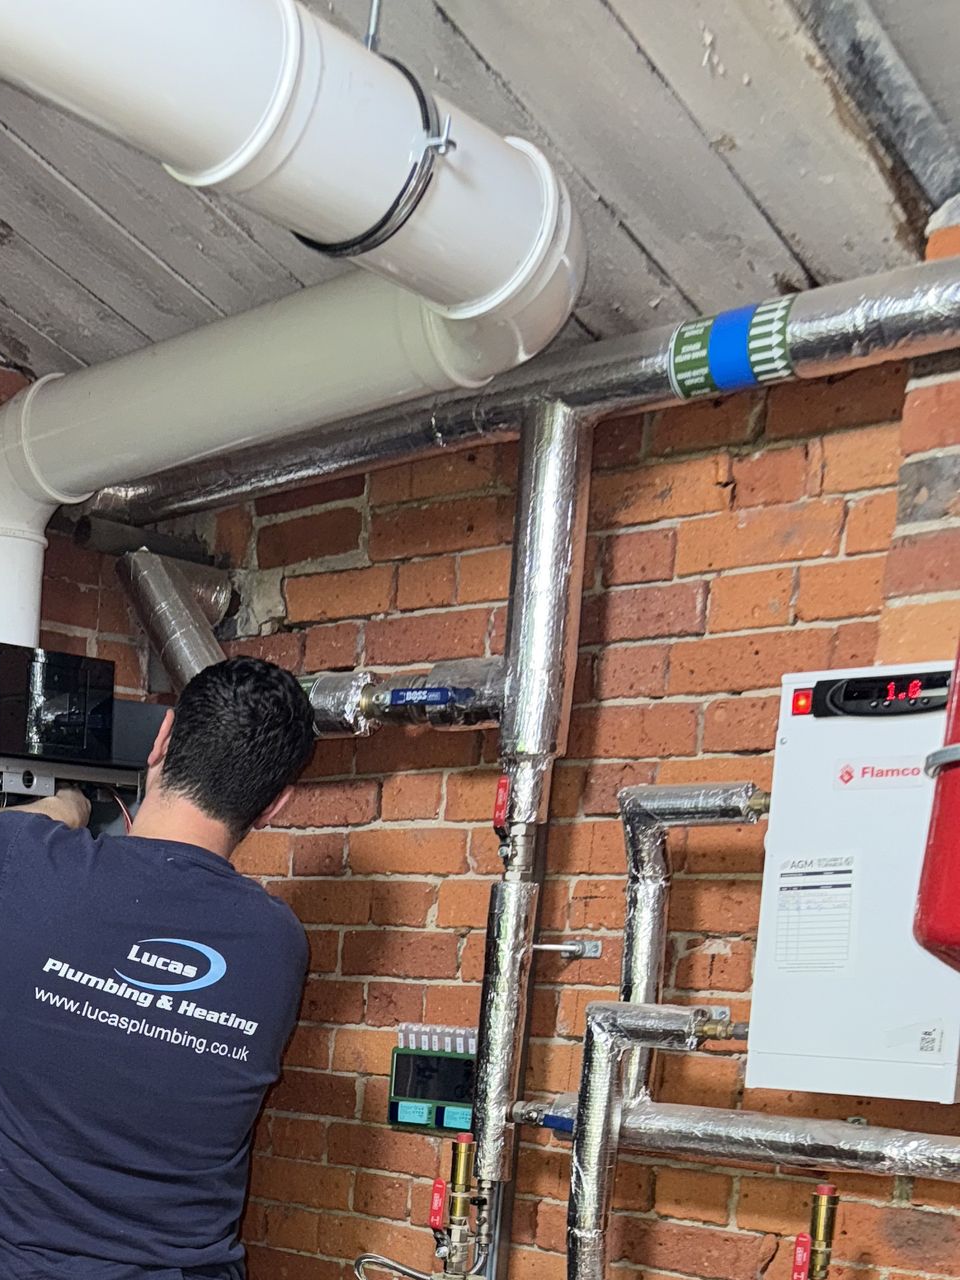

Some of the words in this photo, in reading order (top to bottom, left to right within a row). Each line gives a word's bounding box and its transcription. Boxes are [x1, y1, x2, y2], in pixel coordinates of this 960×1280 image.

[406, 690, 428, 702] BOSS
[860, 765, 921, 778] Flamco
[790, 859, 814, 869] AGM
[126, 944, 198, 978] Lucas
[42, 957, 155, 1008] Plumbing
[155, 994, 173, 1011] &
[177, 1000, 259, 1036] Heating
[34, 986, 249, 1062] www.lucasplumbing.co.uk
